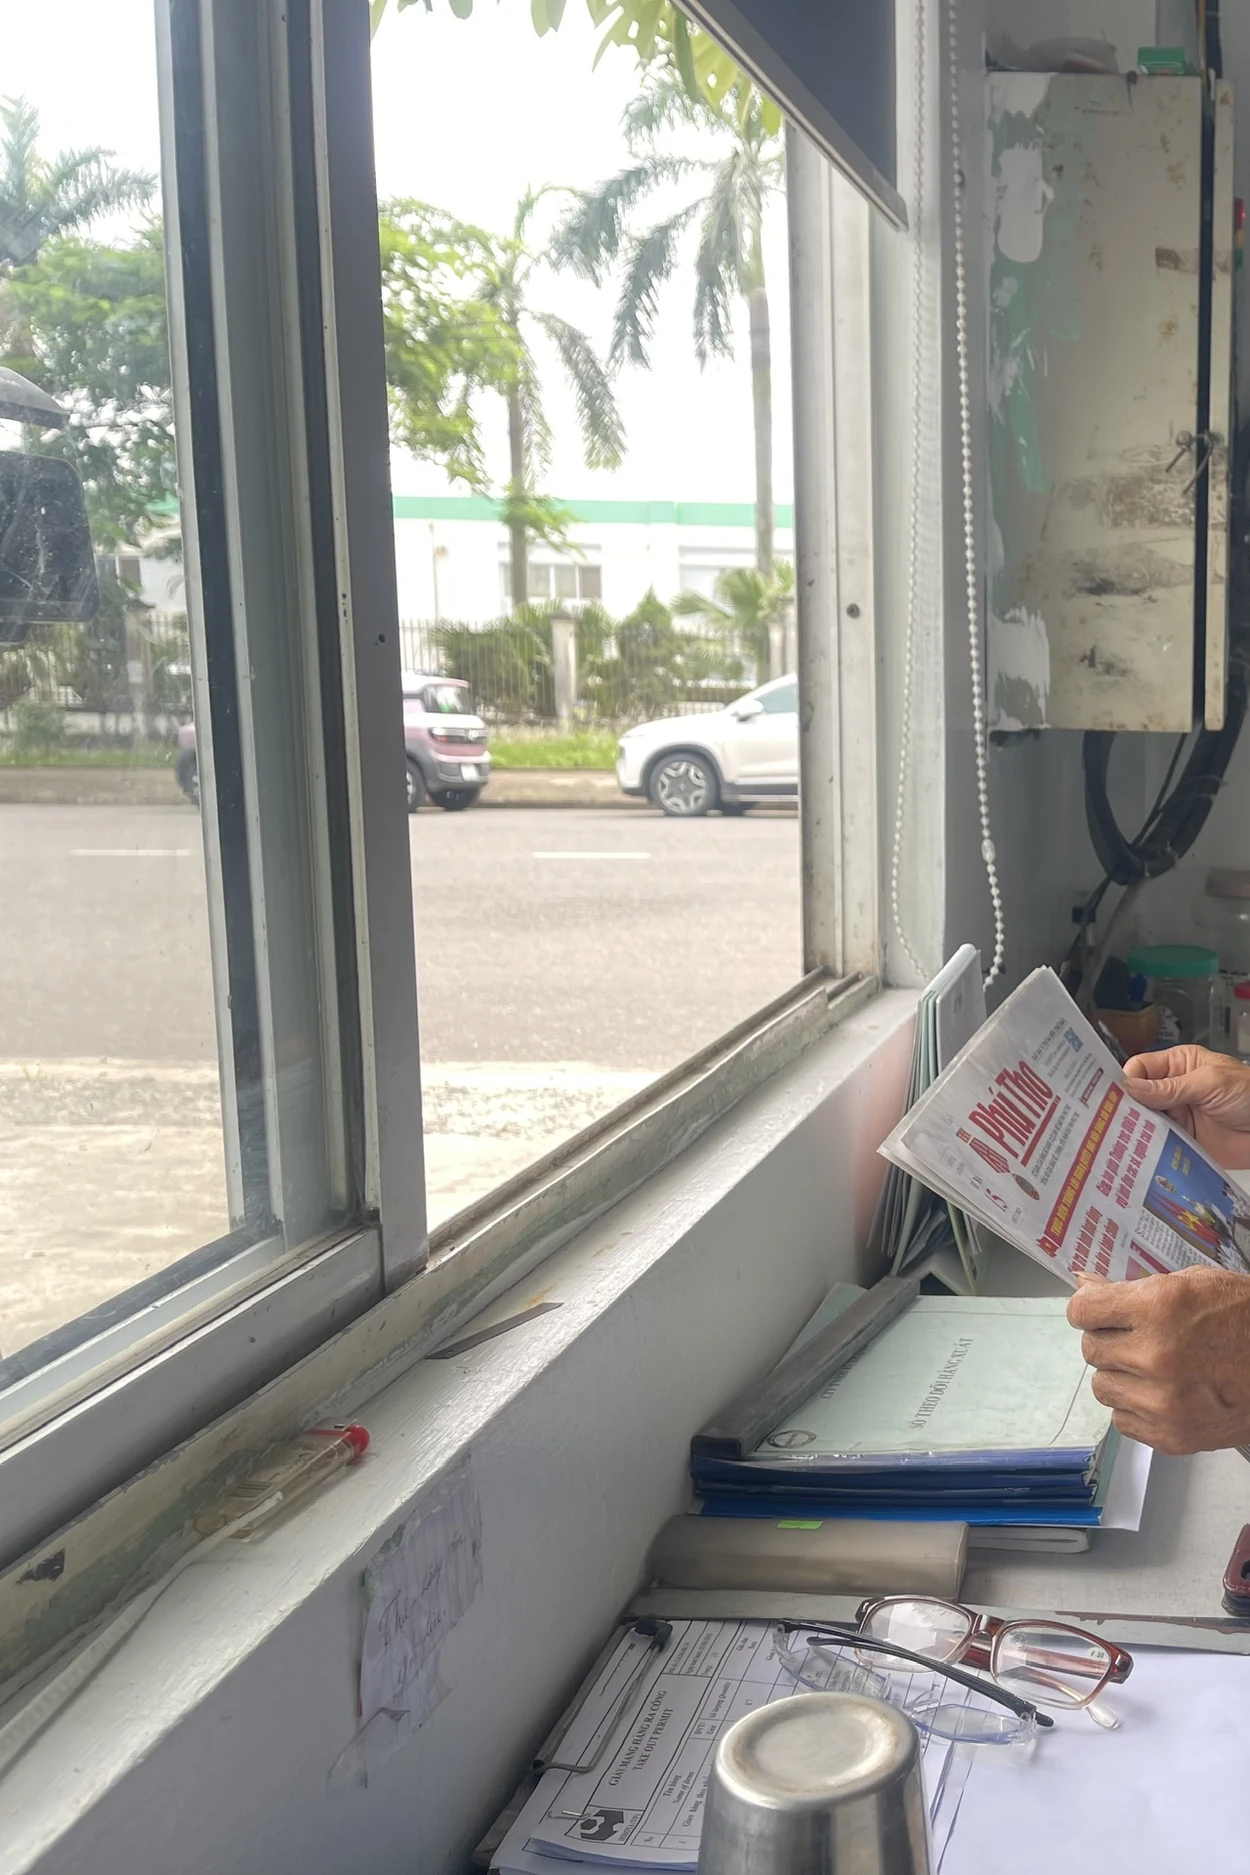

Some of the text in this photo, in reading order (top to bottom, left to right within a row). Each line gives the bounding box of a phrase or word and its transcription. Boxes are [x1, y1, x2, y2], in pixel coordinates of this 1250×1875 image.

[968, 1086, 1036, 1158] Phú
[915, 1396, 940, 1417] THEO
[620, 1746, 638, 1767] MANG
[644, 1713, 656, 1723] RA
[633, 1709, 673, 1770] TAKE OUT PERMIT
[672, 1790, 685, 1804] Name
